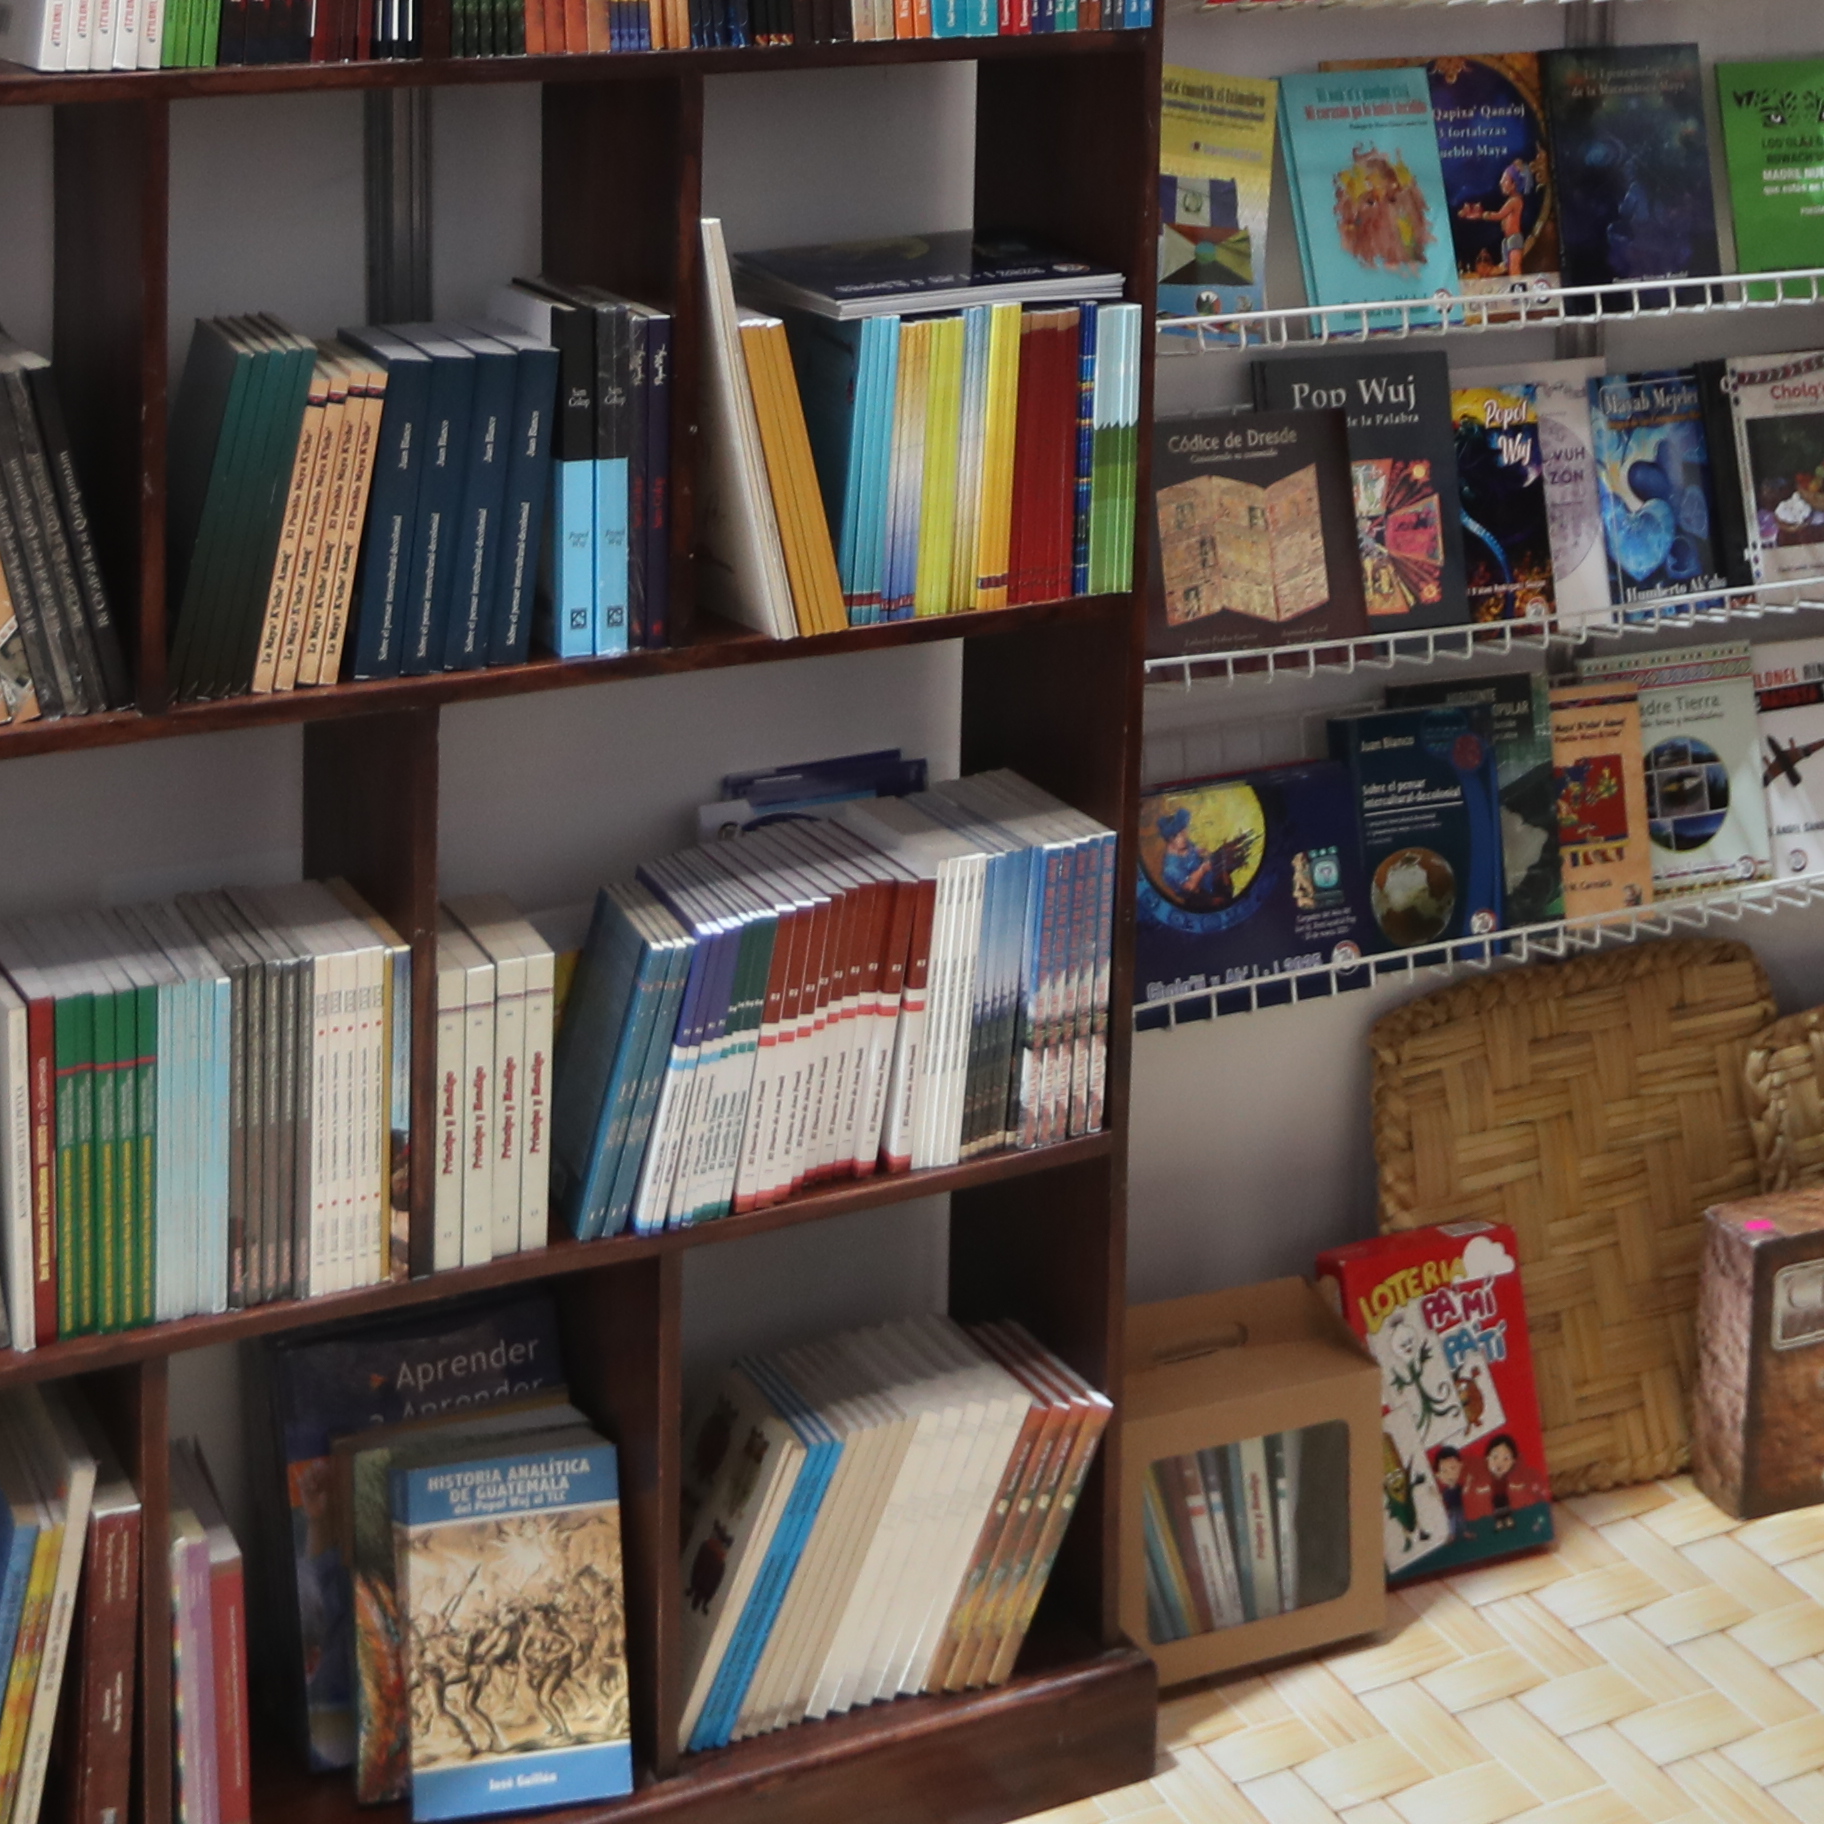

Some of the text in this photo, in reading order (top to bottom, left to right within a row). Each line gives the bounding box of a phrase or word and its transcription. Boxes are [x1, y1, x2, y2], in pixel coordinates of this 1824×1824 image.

[1477, 142, 1508, 158] Maya
[1292, 375, 1416, 411] Pop Wuj
[1168, 426, 1298, 454] Códice de Dresde
[1484, 399, 1531, 466] Popol Wuj
[1639, 693, 1721, 717] adre Tierra
[395, 1336, 542, 1393] Aprender
[426, 1457, 591, 1492] HISTORIA ANALÍTICA
[449, 1475, 571, 1505] DE GUATEMALA
